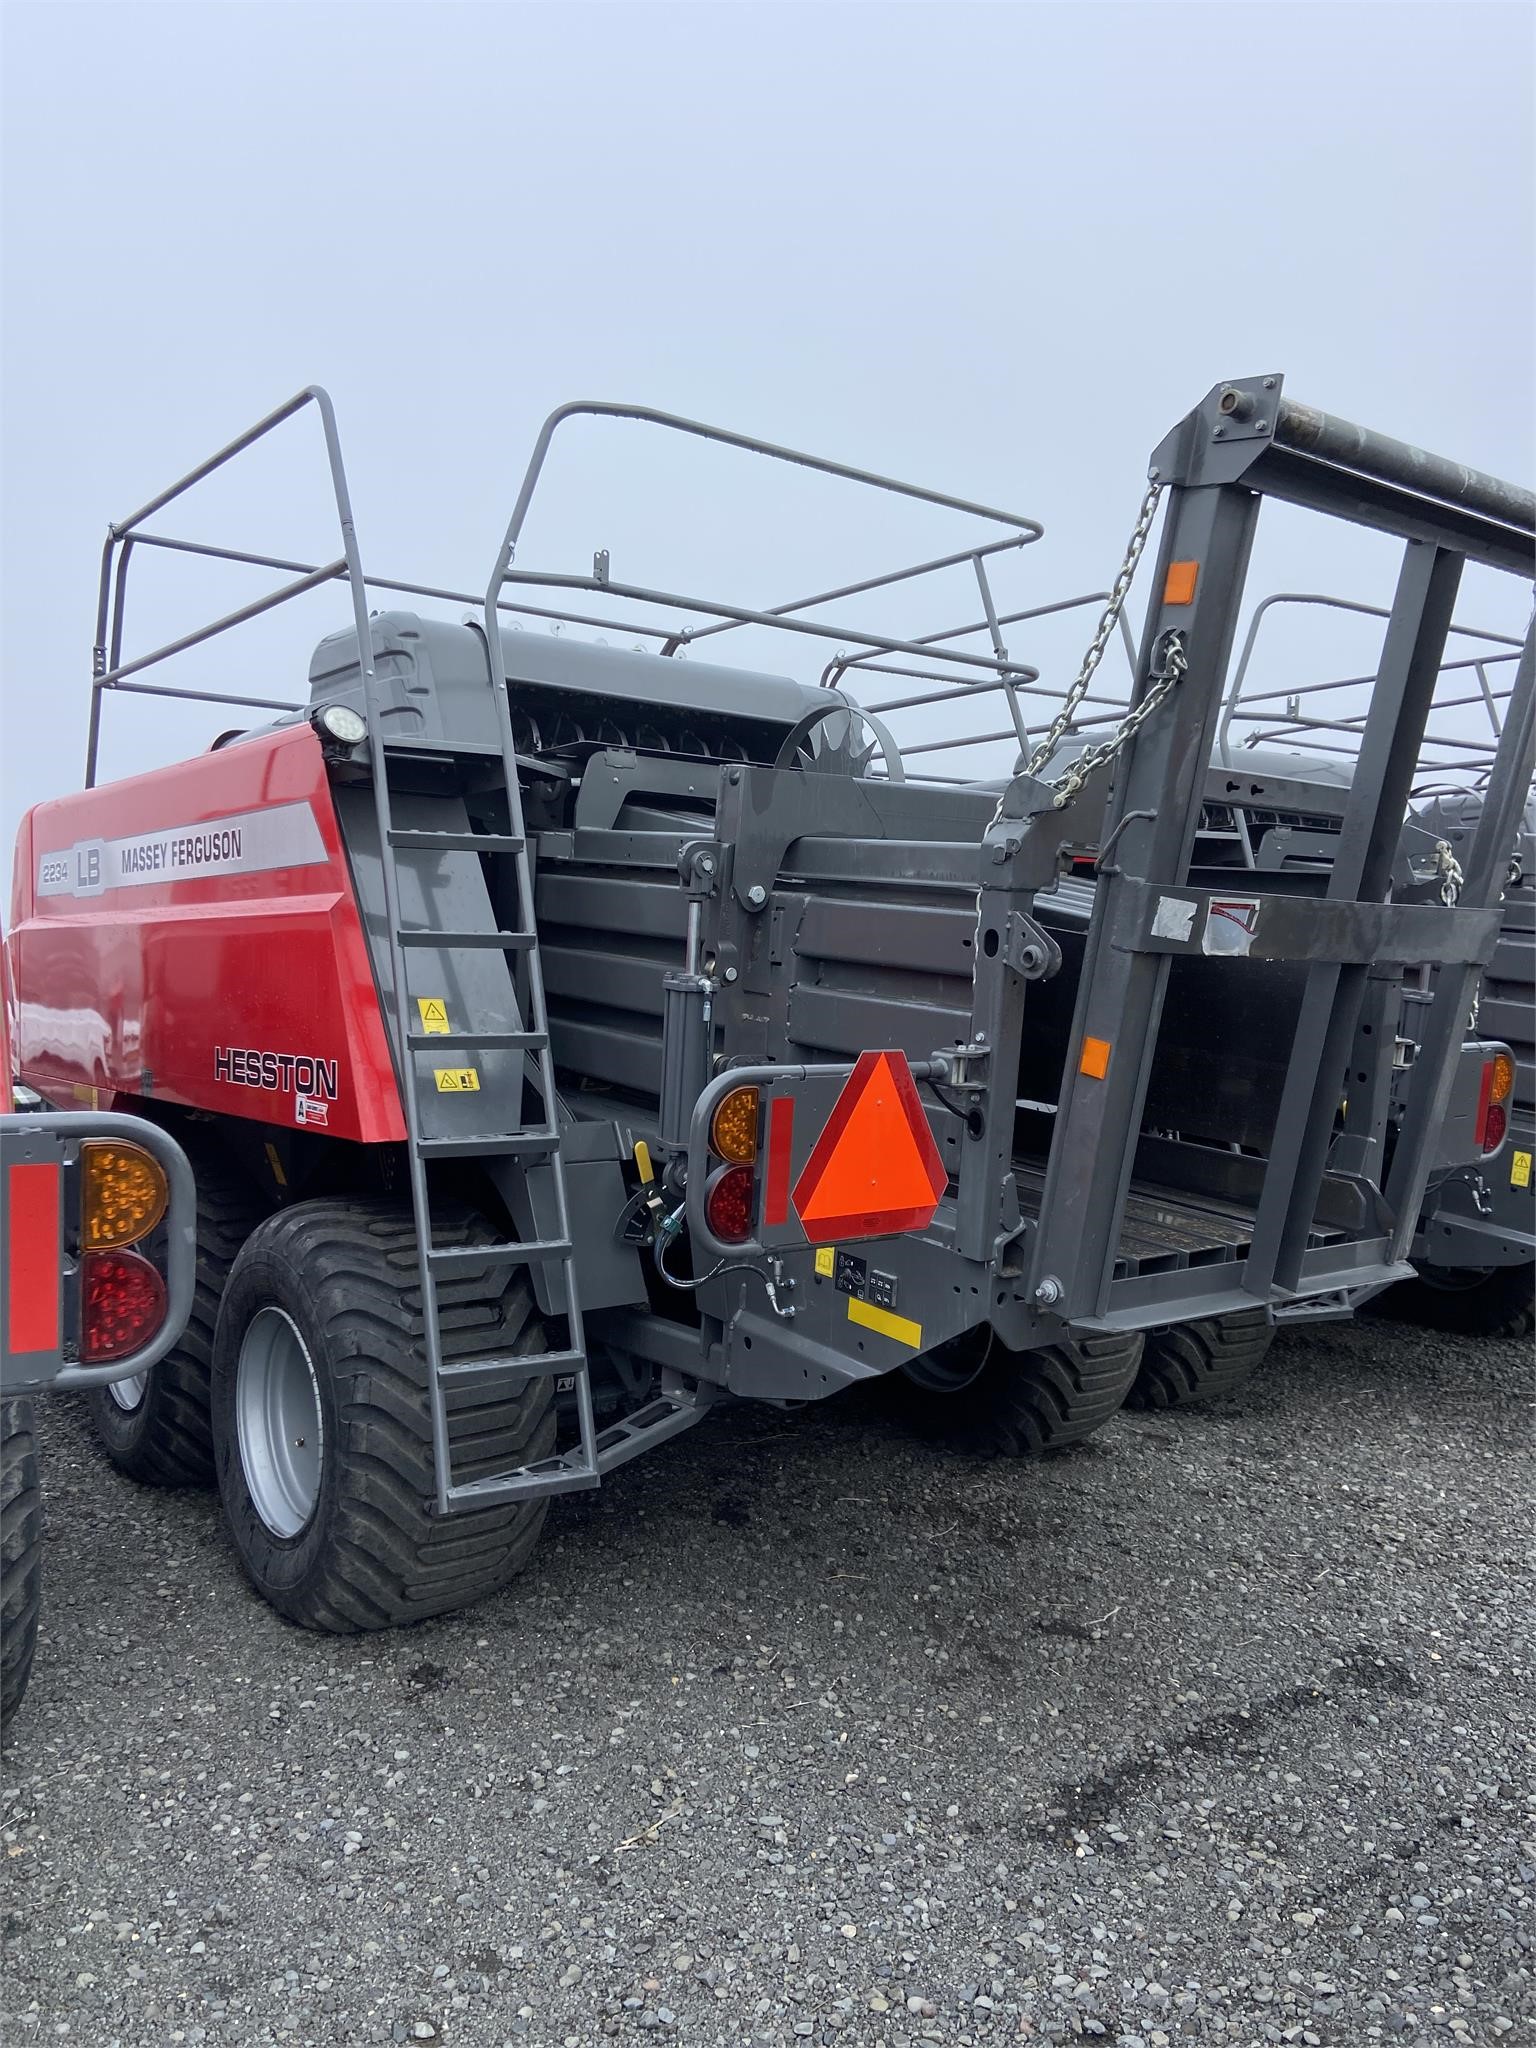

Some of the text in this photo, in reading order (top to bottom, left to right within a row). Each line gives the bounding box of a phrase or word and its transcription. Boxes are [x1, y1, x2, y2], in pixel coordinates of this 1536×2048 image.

[43, 829, 242, 887] 2234 LB MASSEY FERGUSON
[214, 1046, 338, 1100] HESSTON
